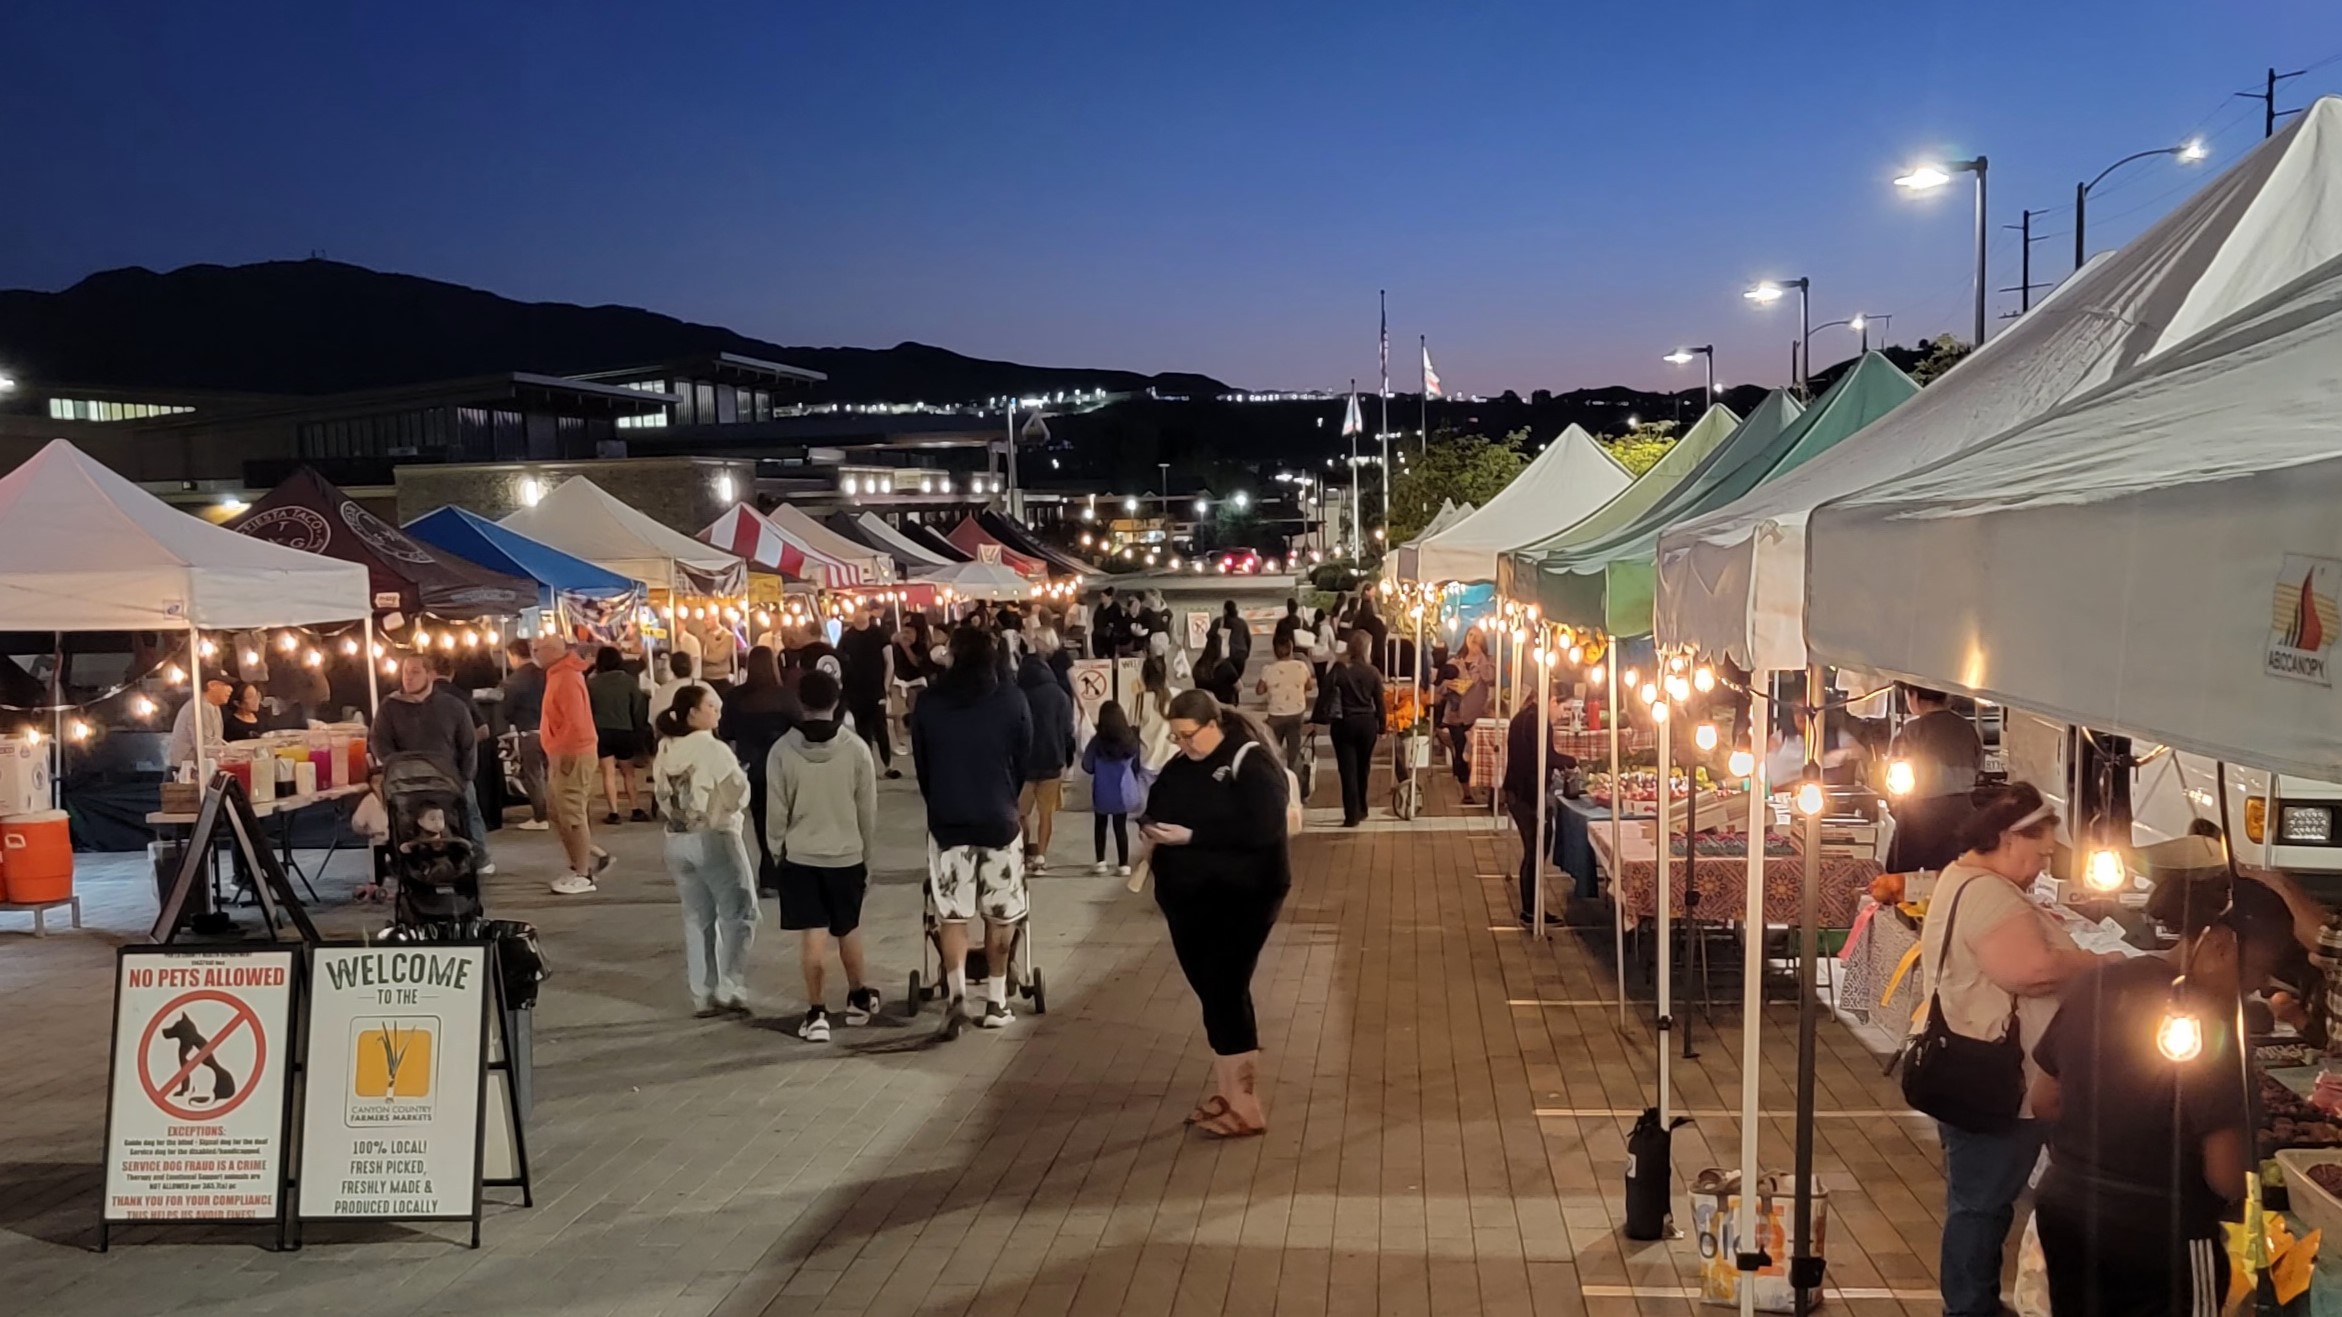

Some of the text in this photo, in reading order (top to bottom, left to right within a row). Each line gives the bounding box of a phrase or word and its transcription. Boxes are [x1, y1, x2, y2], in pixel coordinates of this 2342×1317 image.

[292, 509, 322, 529] TACO
[129, 967, 285, 988] NO PETS ALLOWED
[325, 953, 472, 990] WELCOME
[377, 989, 418, 1004] TO THE
[352, 1105, 432, 1114] CANYON COUNTRY
[351, 1114, 389, 1122] FARMERS
[167, 1126, 227, 1137] EXCEPTIONS:
[353, 1140, 427, 1154] 100% LOCAL!
[122, 1160, 266, 1172] SERVICE DOG FRAUD IS A CRIME
[350, 1160, 427, 1175] FRESH PICKED,
[341, 1180, 433, 1194] FRESHLY MADE &
[112, 1195, 273, 1206] THANK YOU FOR YOUR COMPLIANCE
[334, 1200, 438, 1214] PRODUCED LOCALLY
[127, 1210, 148, 1219] THIS
